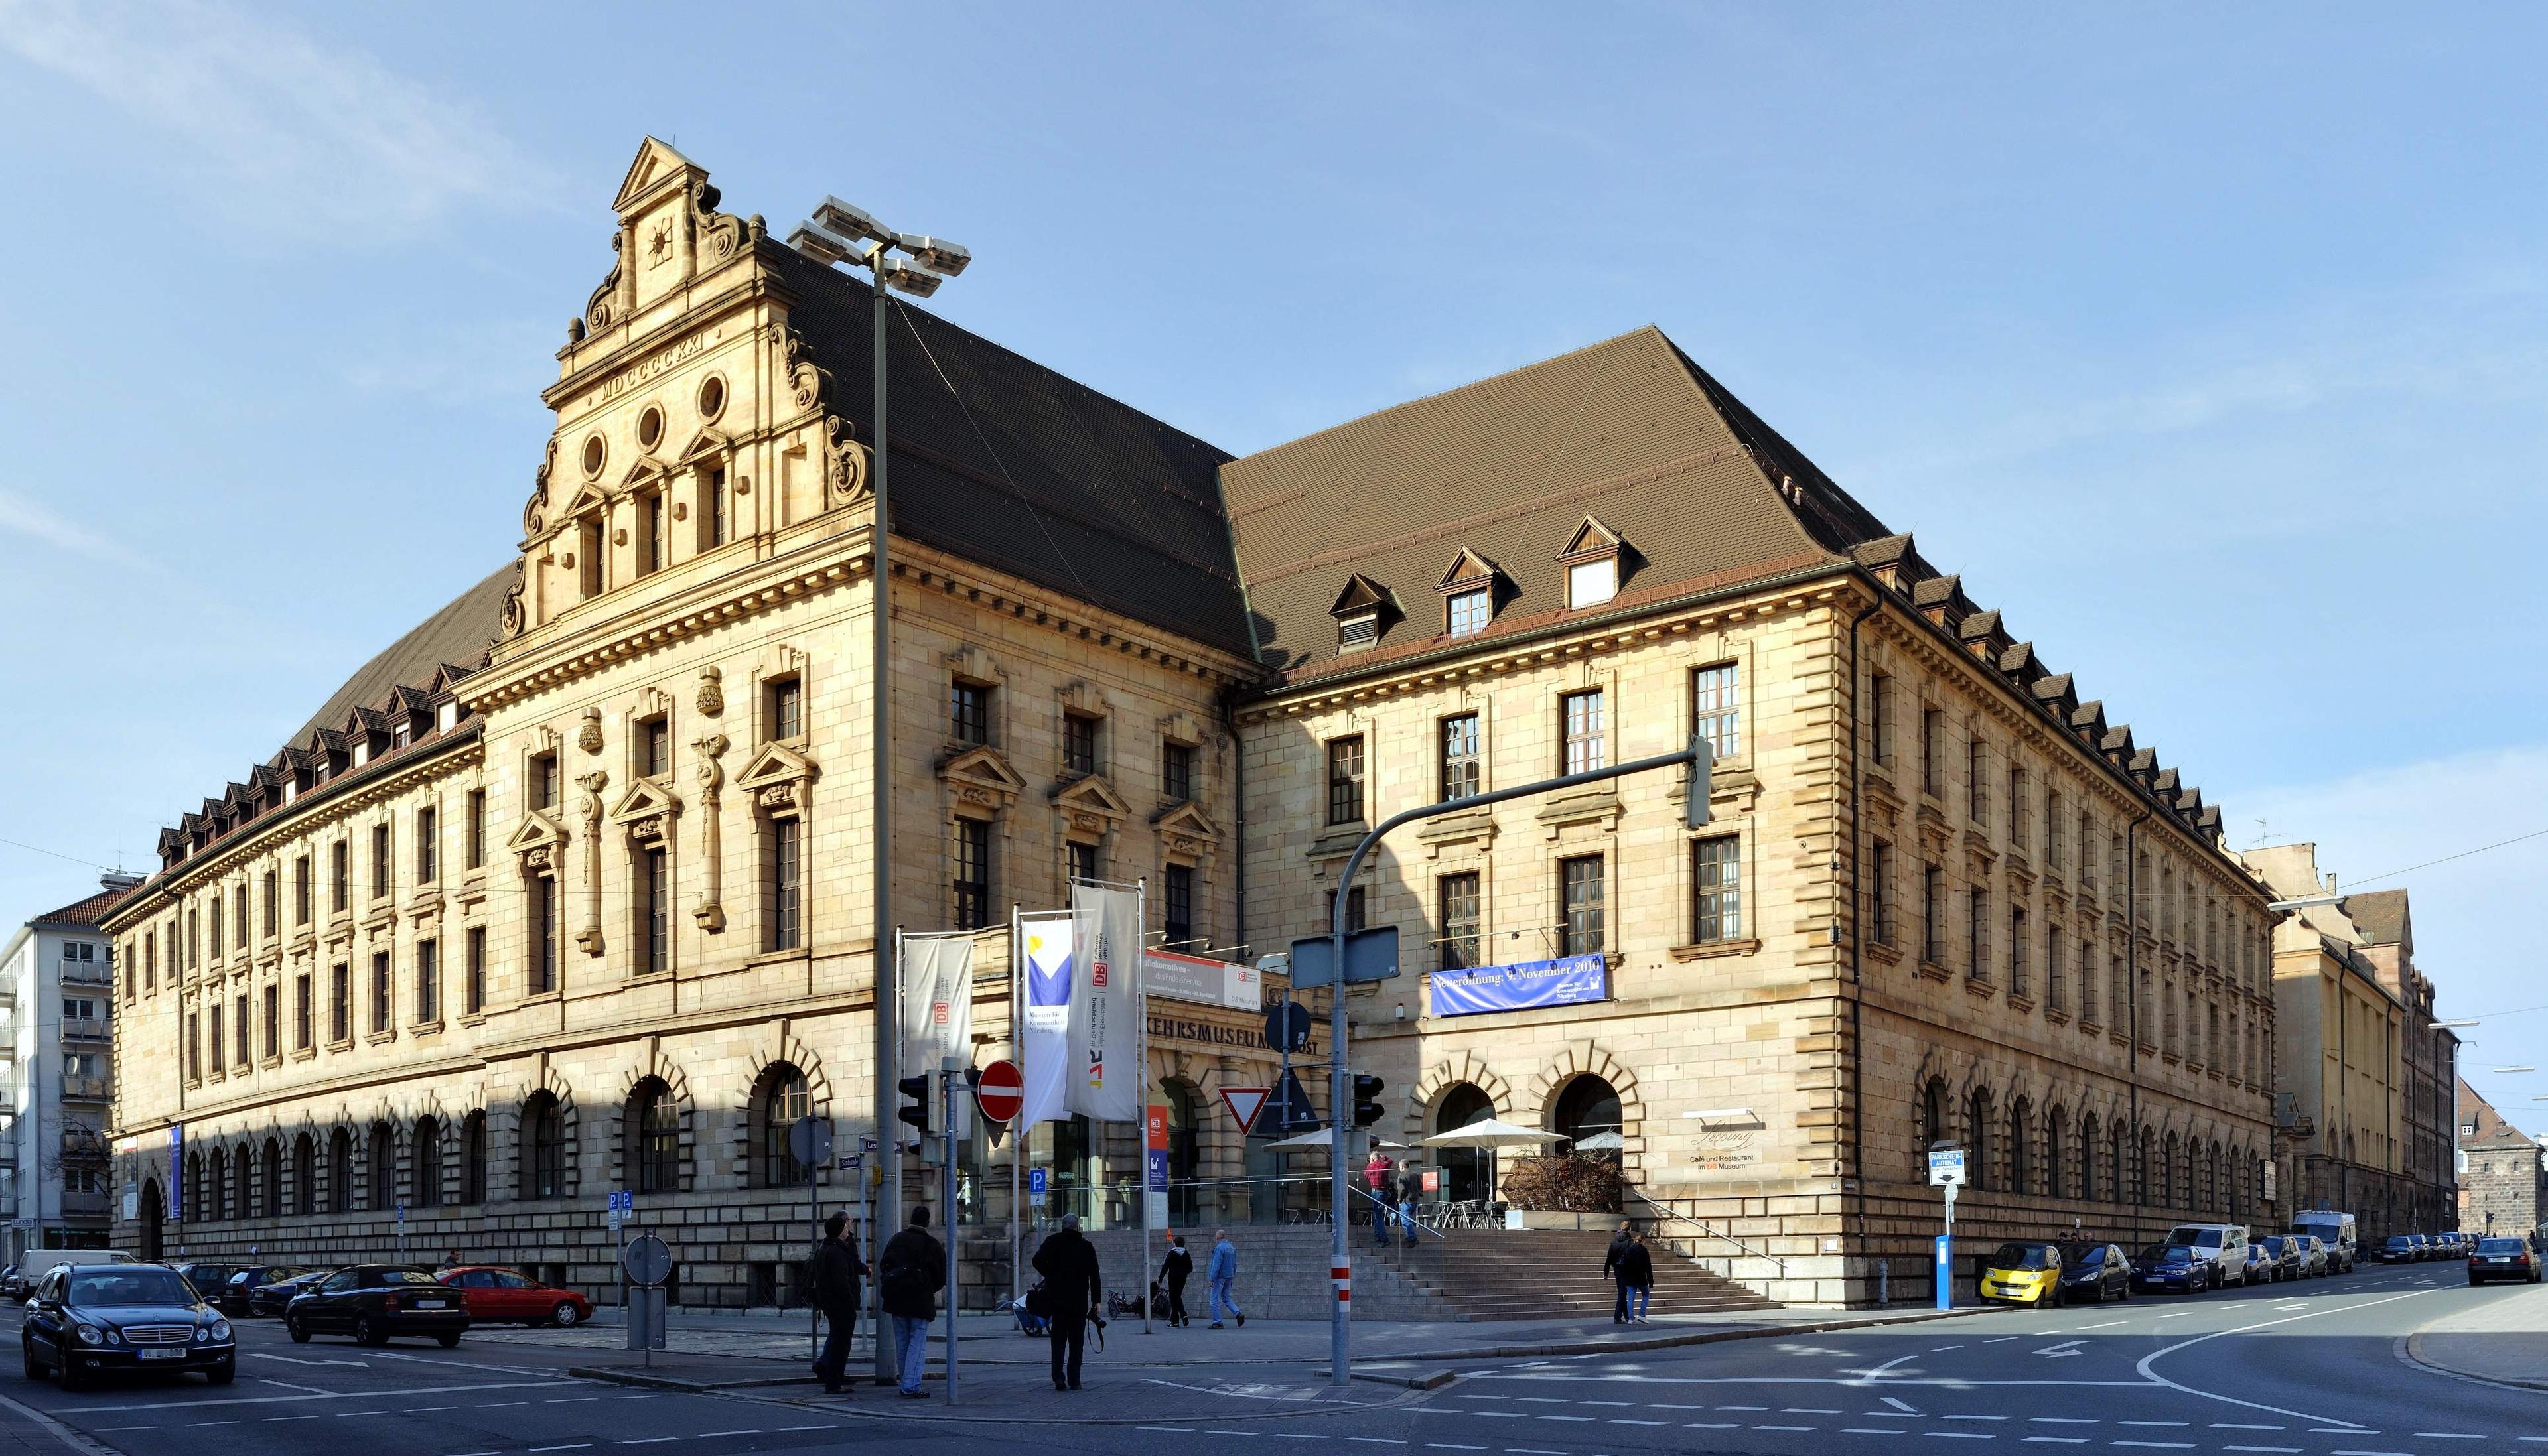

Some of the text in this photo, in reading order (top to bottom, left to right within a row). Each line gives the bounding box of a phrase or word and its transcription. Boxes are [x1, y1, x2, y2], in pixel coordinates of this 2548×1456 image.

[1238, 972, 1246, 981] DB
[1433, 960, 1600, 988] Neueröffnung: 9. November 2010
[936, 1004, 946, 1021] DB
[1691, 1120, 1754, 1152] Lessing
[1034, 1173, 1042, 1190] P
[610, 1195, 616, 1208] P
[624, 1193, 630, 1207] P
